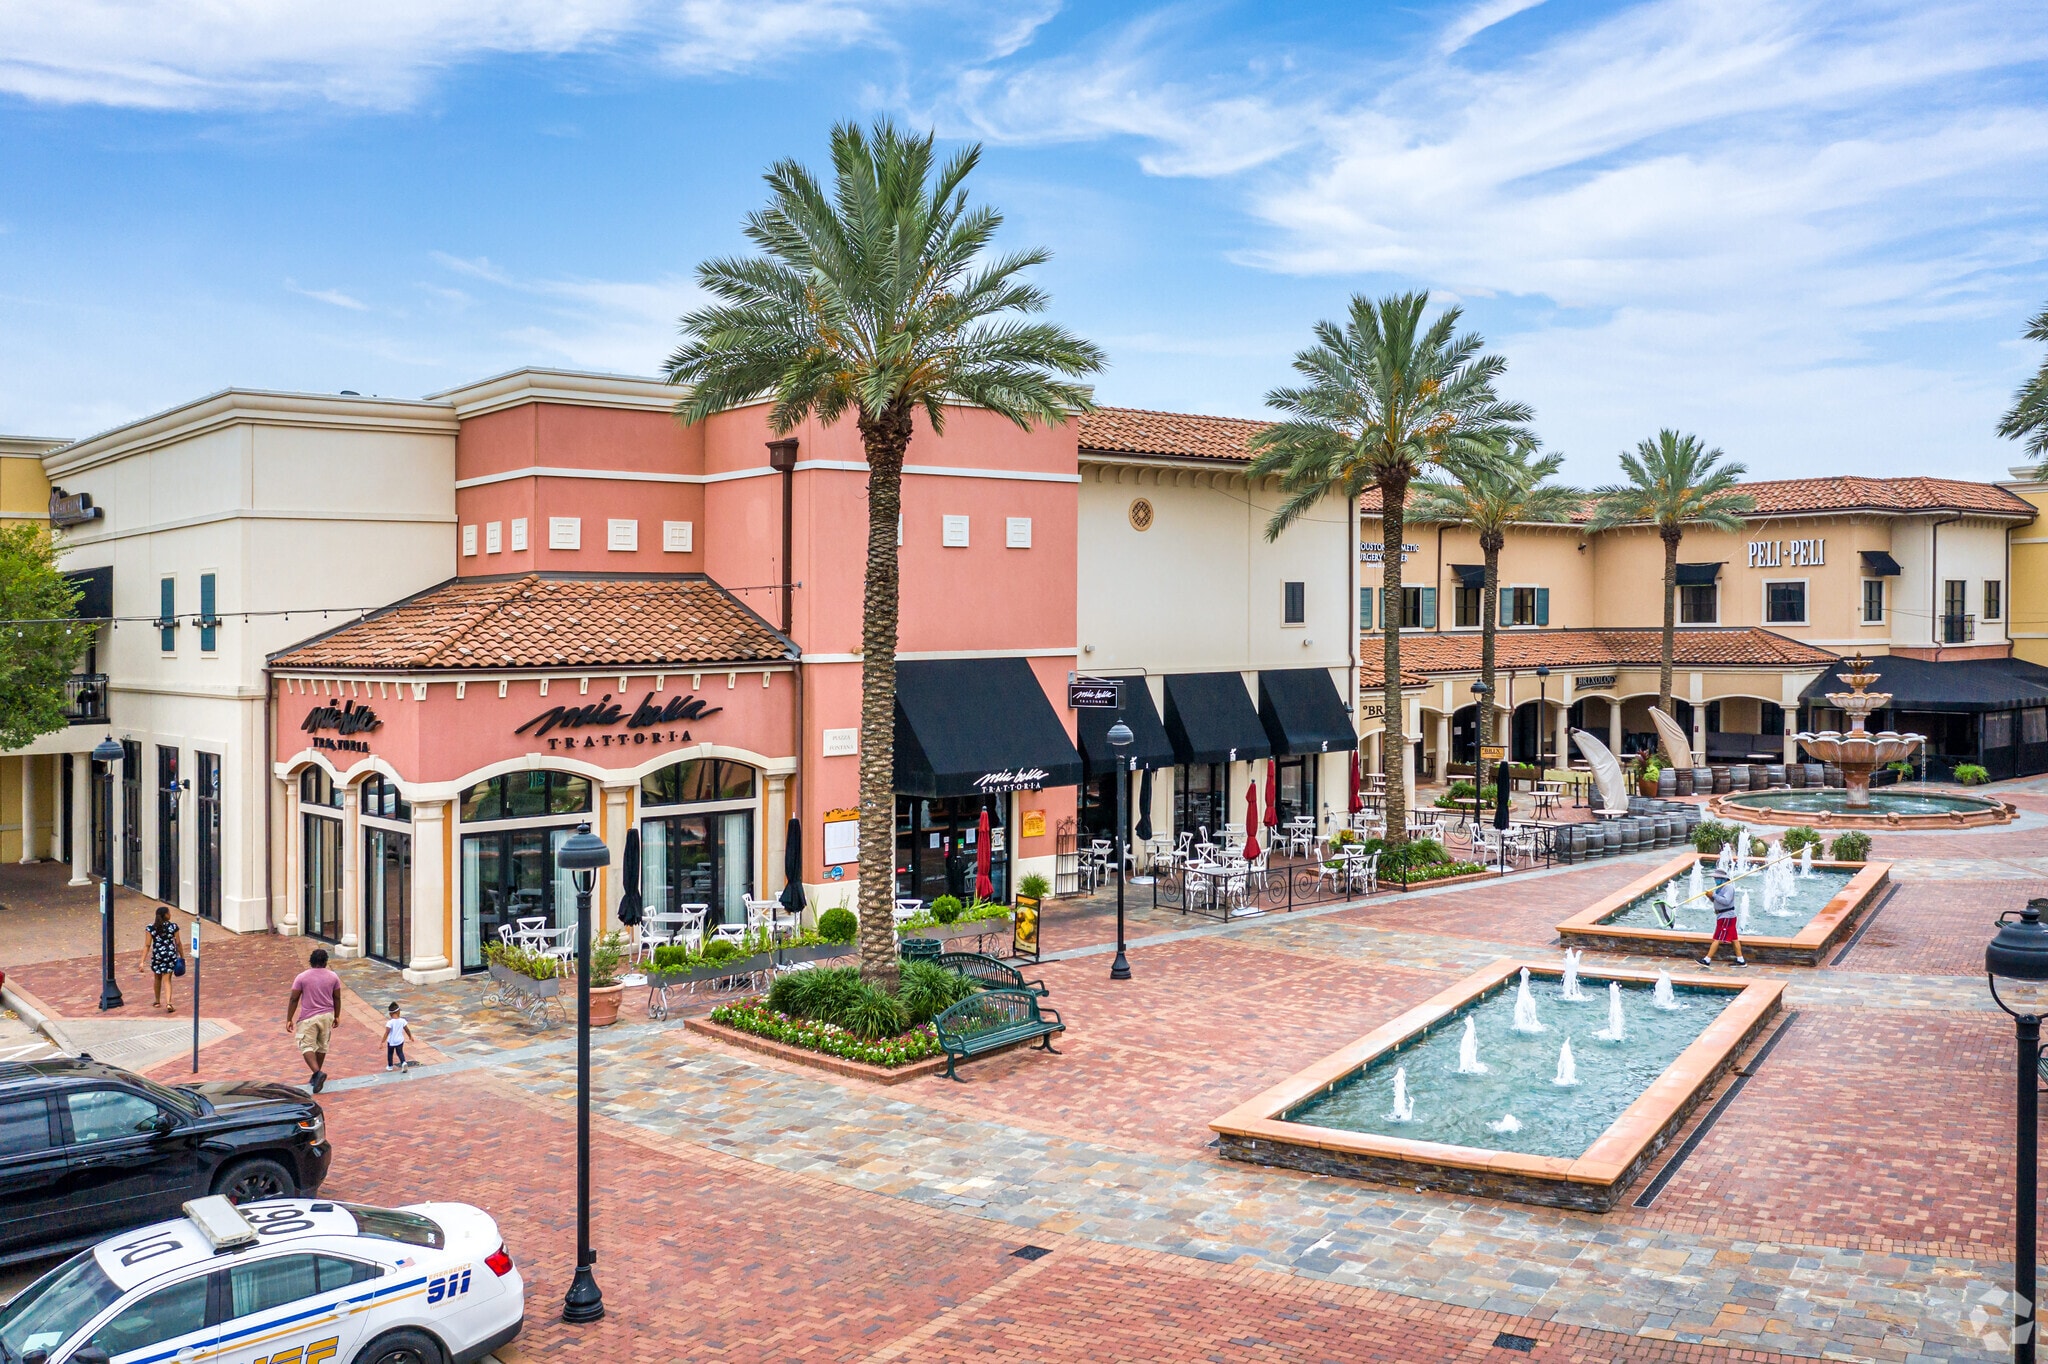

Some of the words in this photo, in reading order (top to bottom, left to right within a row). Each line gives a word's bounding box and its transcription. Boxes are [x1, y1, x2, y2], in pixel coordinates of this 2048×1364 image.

[1748, 541, 1782, 567] PELI
[1790, 539, 1825, 566] PELI
[514, 694, 632, 737] mia
[626, 692, 723, 728] bella
[973, 768, 1015, 787] mia
[1013, 767, 1050, 784] bella
[427, 1269, 472, 1304] 911
